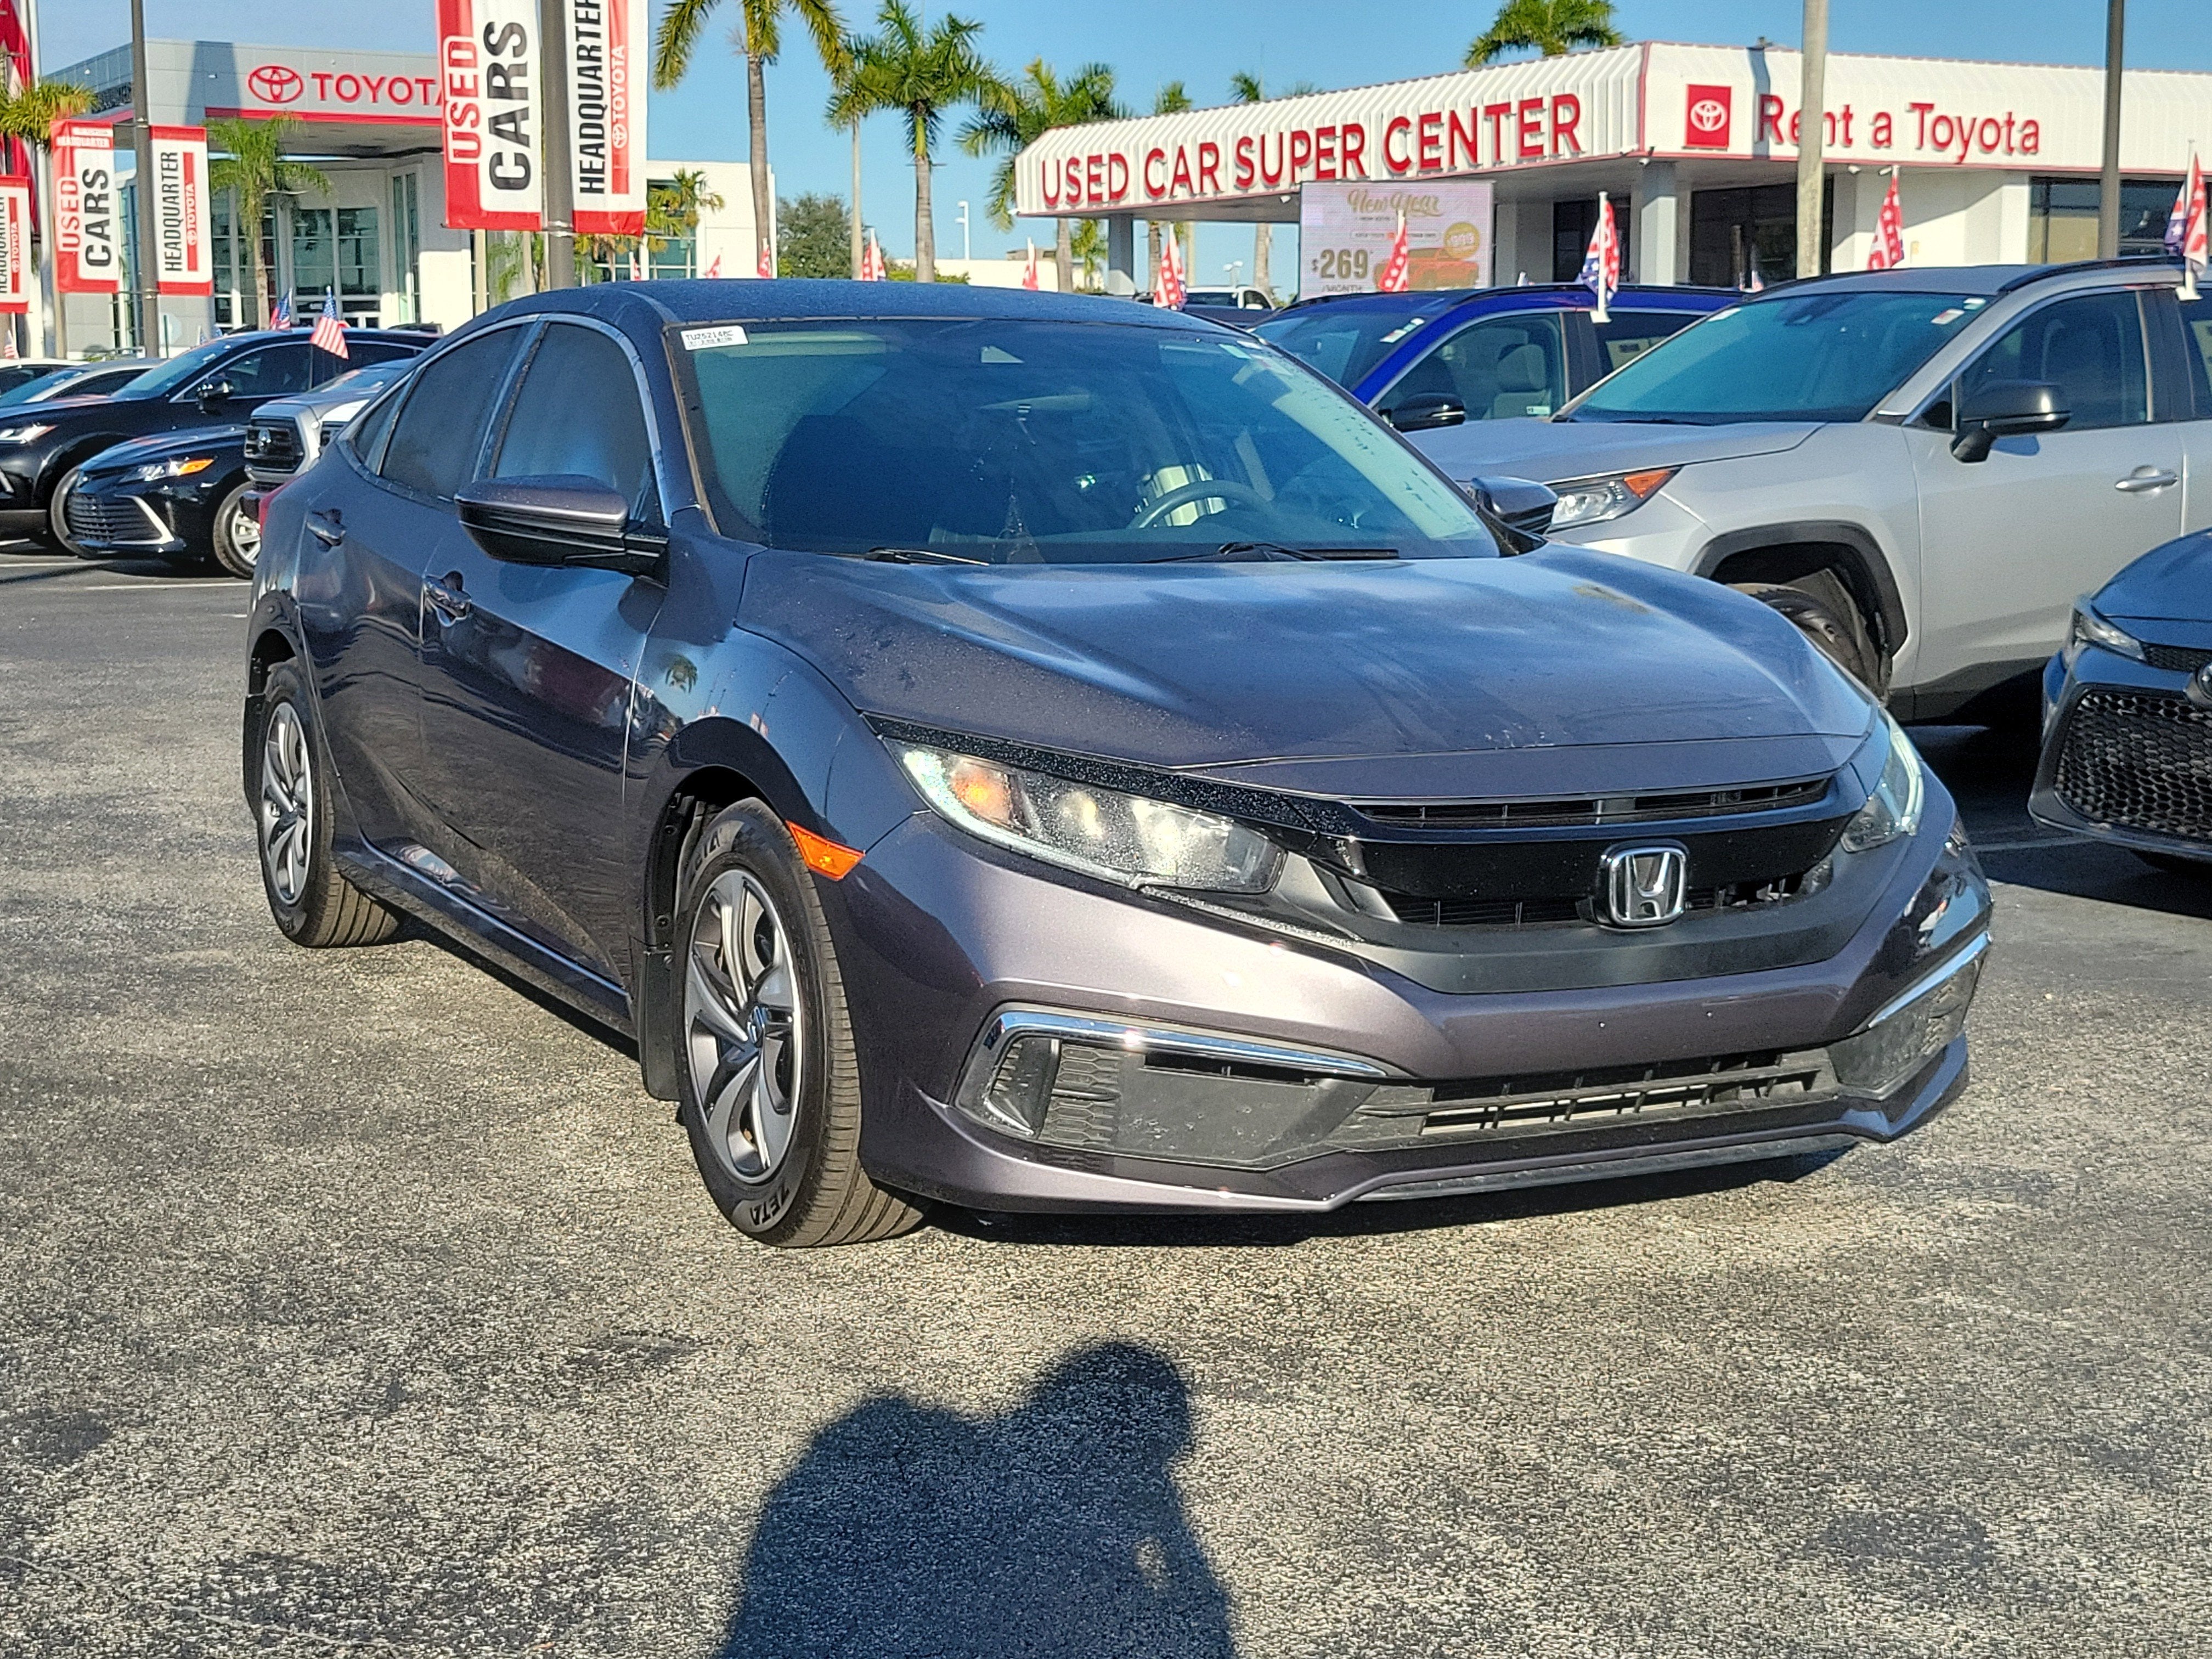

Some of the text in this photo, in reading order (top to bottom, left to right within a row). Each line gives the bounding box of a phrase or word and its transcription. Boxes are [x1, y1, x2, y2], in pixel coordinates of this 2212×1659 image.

[311, 72, 442, 106] TOYOT
[448, 41, 482, 160] USED
[483, 21, 532, 190] CARS
[612, 45, 625, 123] TOYOTA
[1042, 93, 1581, 207] USED CAR SUPER CENTER
[1872, 111, 1892, 148] a
[1908, 101, 2039, 165] Toyota
[61, 180, 80, 248] USED
[82, 168, 111, 267] CARS
[160, 152, 183, 271] HEADQUARTER
[185, 183, 196, 228] TOYOTA
